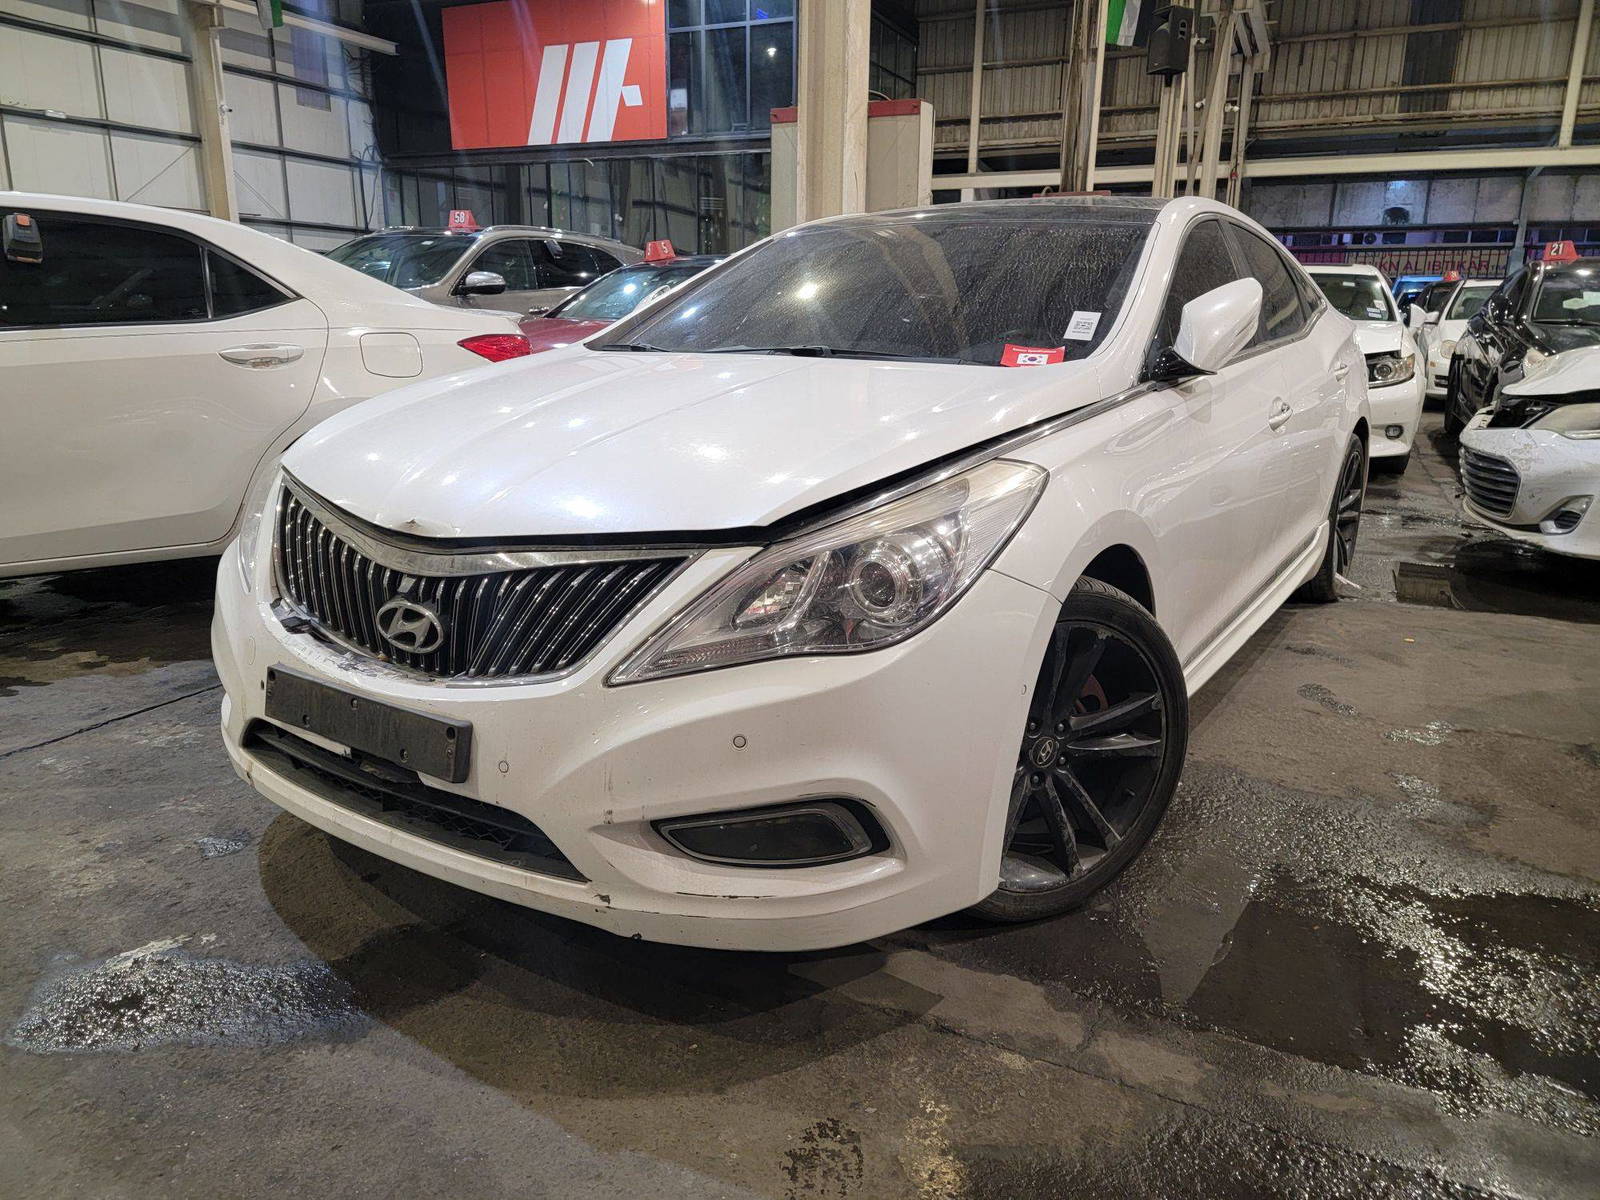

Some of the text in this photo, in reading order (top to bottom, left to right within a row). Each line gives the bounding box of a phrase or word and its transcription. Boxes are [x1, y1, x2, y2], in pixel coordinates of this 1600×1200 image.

[454, 211, 465, 223] 58
[1551, 242, 1564, 256] 21
[1402, 260, 1423, 271] AL
[1426, 260, 1489, 272] IBTIKAR
